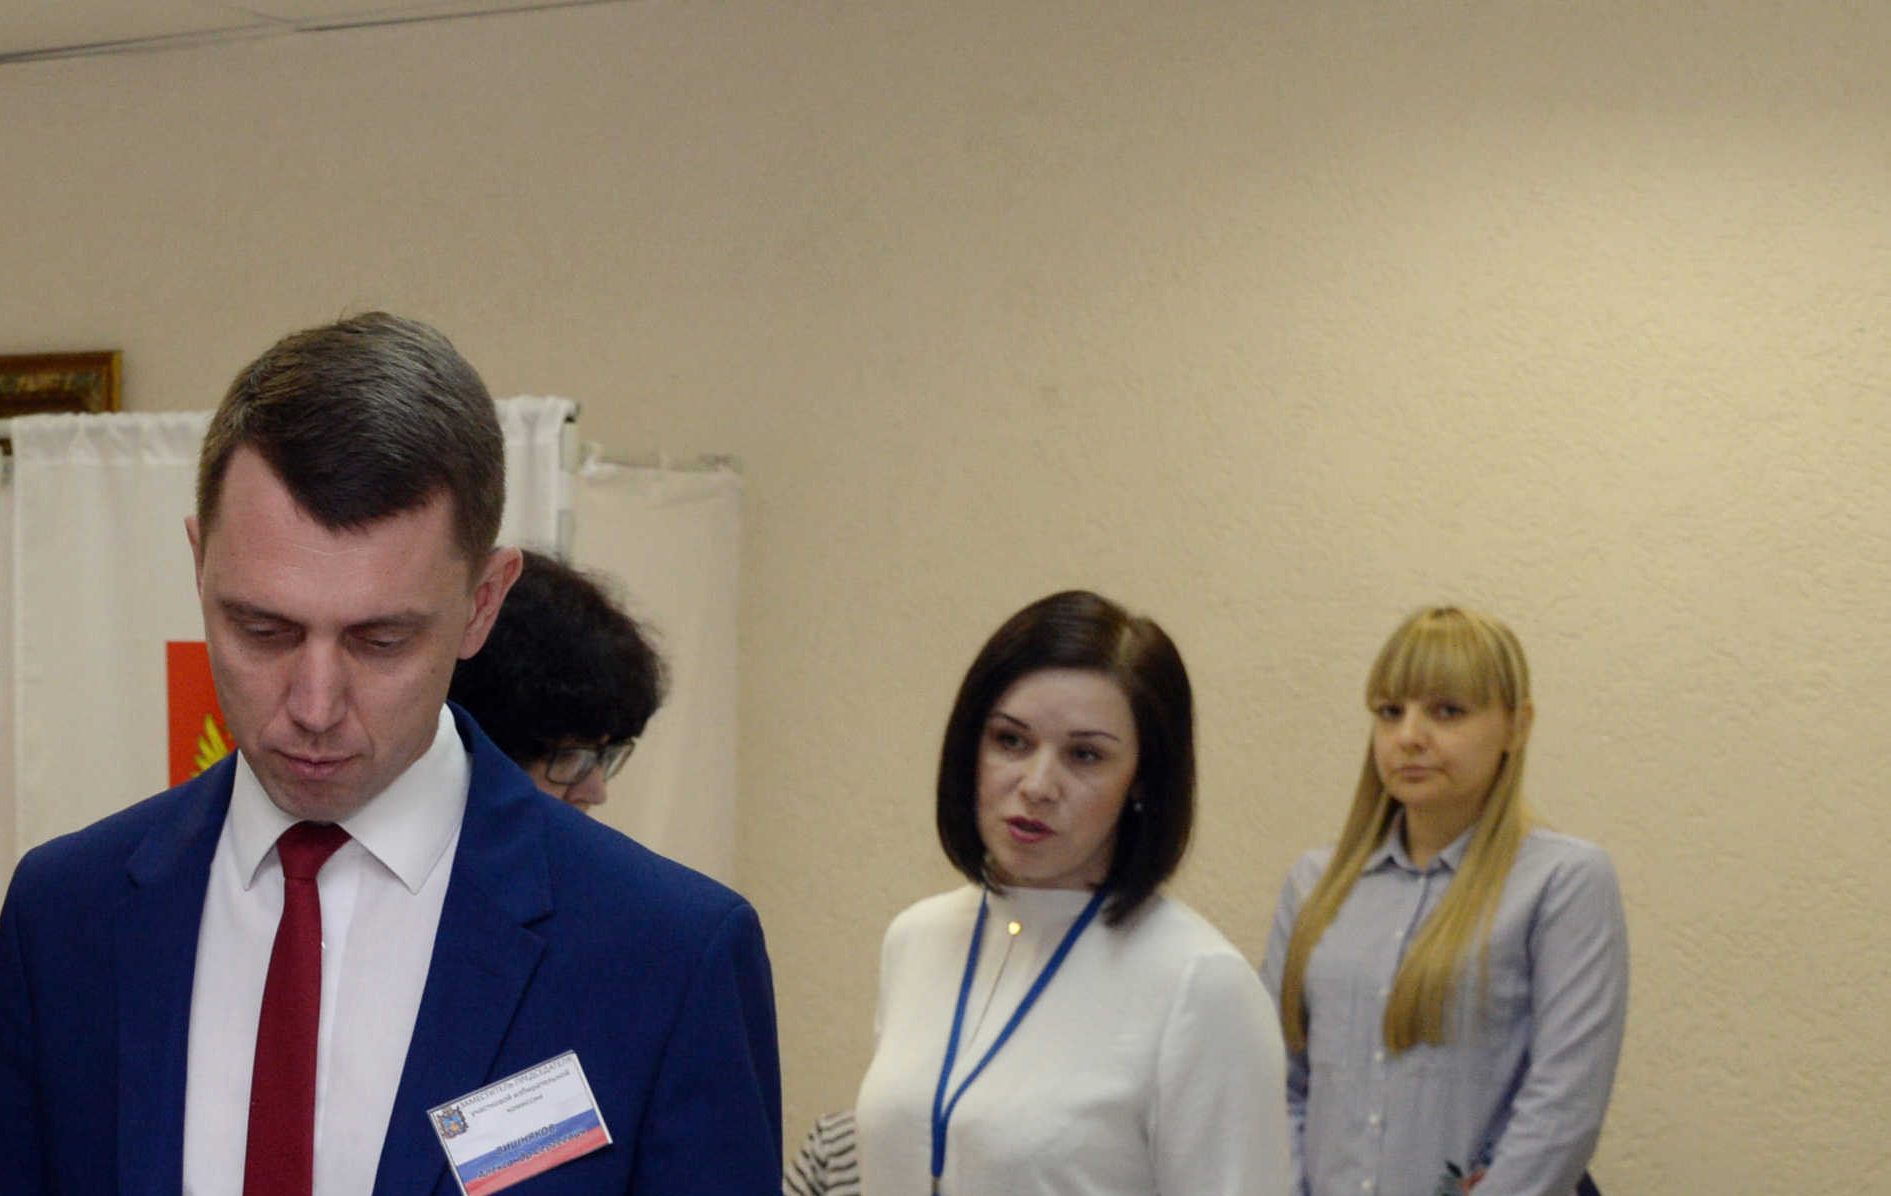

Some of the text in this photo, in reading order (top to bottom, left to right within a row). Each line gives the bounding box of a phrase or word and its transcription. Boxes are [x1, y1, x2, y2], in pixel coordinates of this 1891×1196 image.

[460, 1079, 514, 1109] ЗАМЕСТИТЕЛЬ
[470, 1069, 570, 1118] участковой избирательной
[507, 1094, 543, 1113] комиссии
[496, 1123, 556, 1155] ВИШНЯКОВ
[478, 1151, 533, 1179] Александр
